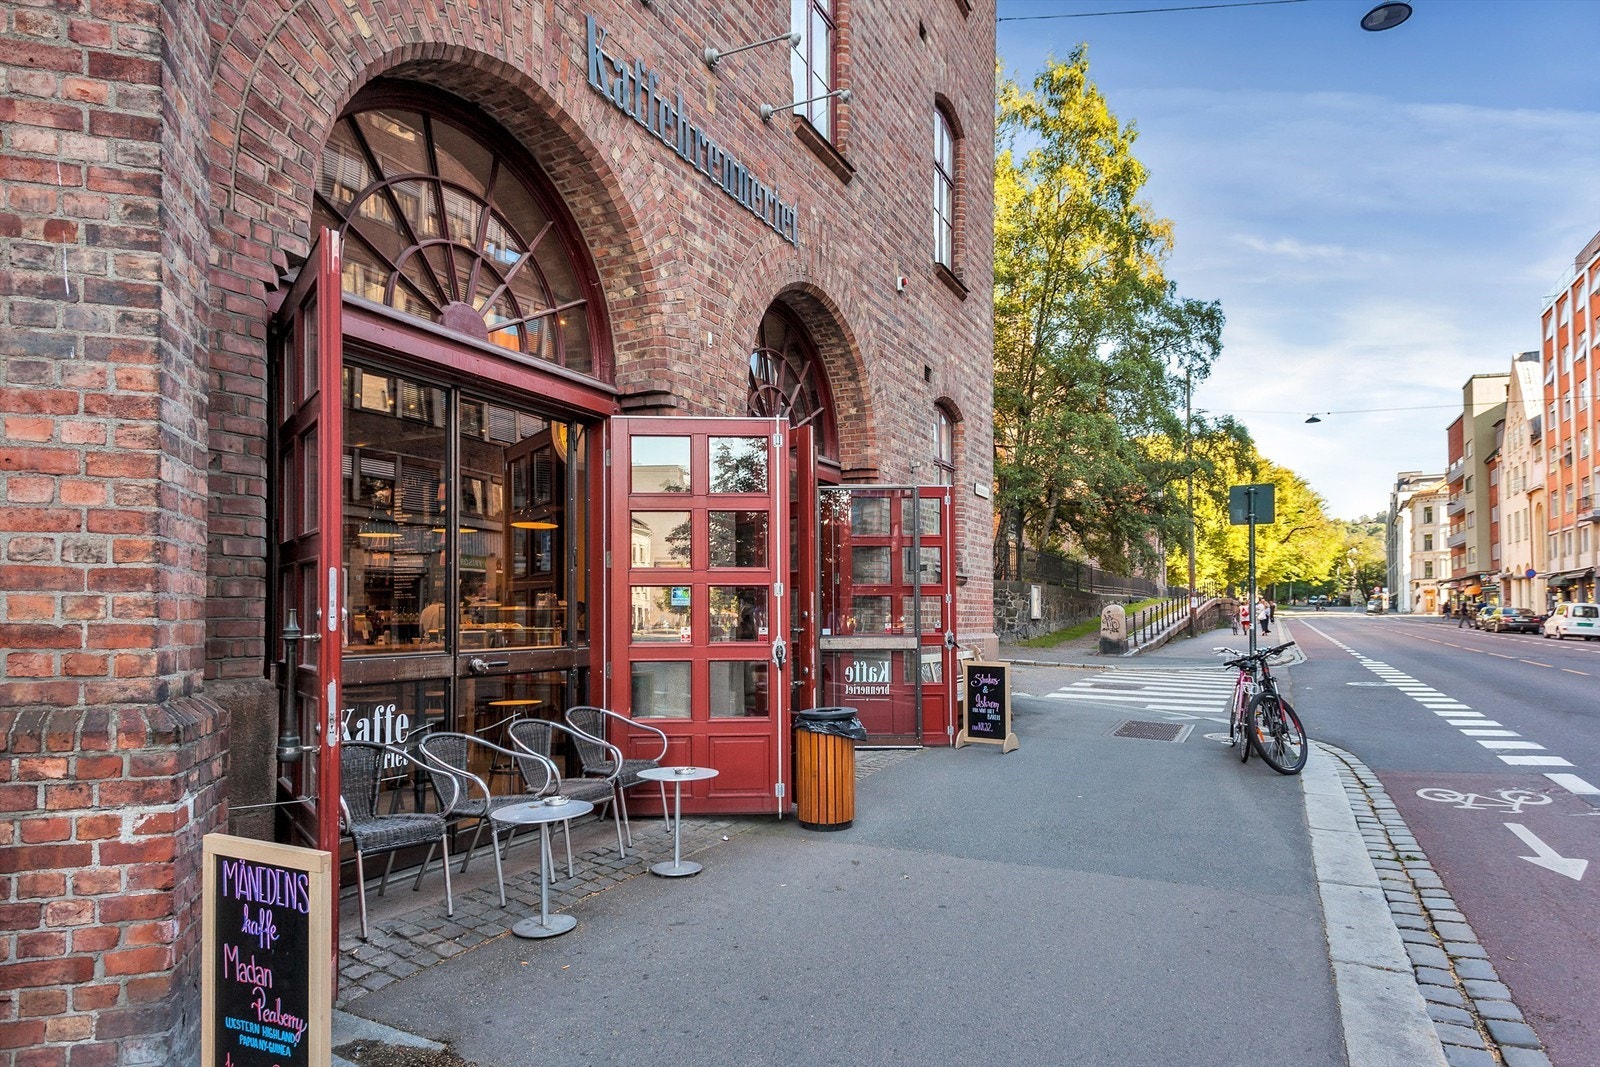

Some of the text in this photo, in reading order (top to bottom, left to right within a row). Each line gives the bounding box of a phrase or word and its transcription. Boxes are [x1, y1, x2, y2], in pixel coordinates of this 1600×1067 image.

[586, 14, 799, 248] Kaffebrenneriet
[341, 703, 409, 744] Kaffe
[222, 859, 310, 914] MÅNEDENS
[241, 903, 280, 949] kaffe
[223, 943, 273, 989] Madan
[225, 1016, 260, 1034] WESTERN
[250, 986, 308, 1043] Peaberry
[239, 1034, 258, 1049] PAPUA
